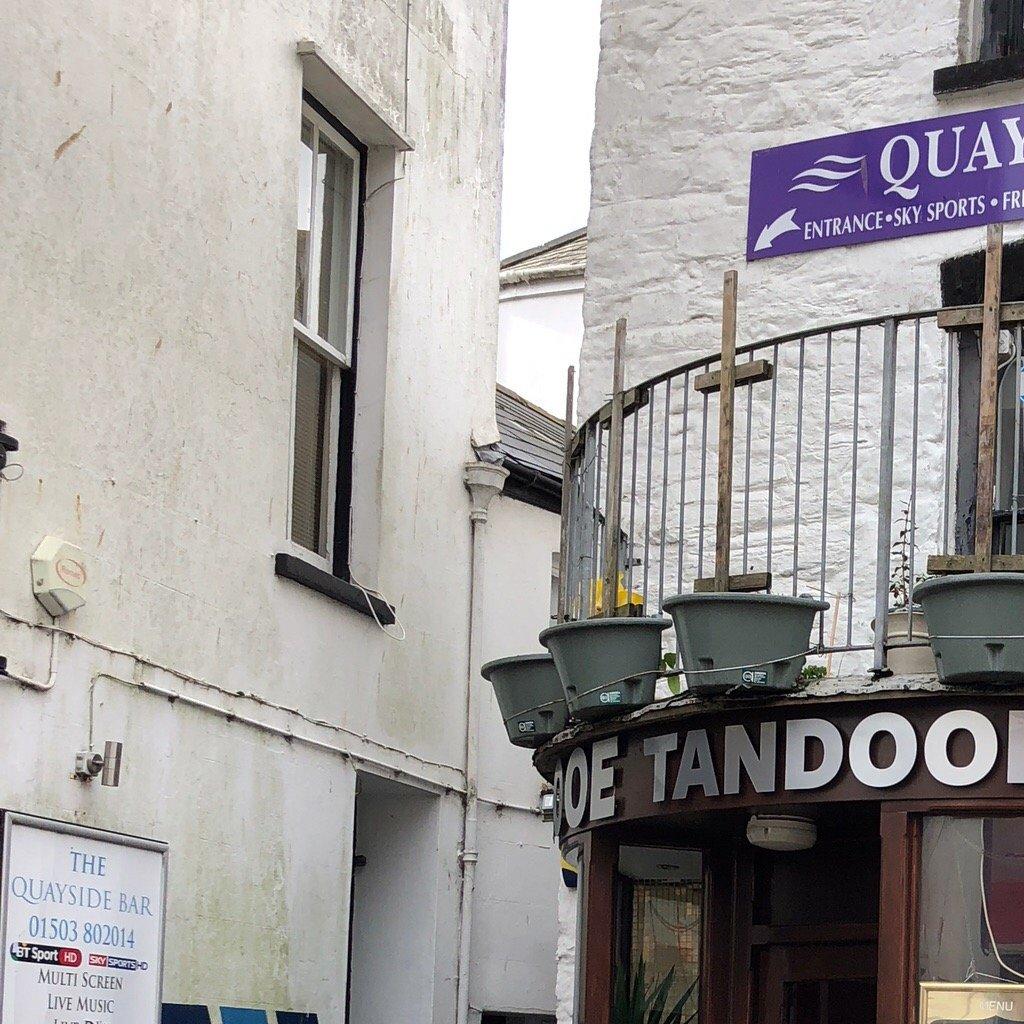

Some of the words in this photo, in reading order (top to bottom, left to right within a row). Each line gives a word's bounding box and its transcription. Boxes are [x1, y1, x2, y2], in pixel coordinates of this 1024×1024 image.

[803, 211, 884, 241] ENTRANCE
[892, 207, 923, 230] SKY
[926, 194, 986, 225] SPORTS
[554, 736, 618, 834] OOE
[71, 852, 106, 877] THE
[11, 877, 111, 911] QUAYSIDE
[119, 890, 153, 917] BAR
[29, 915, 78, 943] 01503
[83, 922, 135, 948] 802014
[32, 946, 58, 962] Sport
[64, 952, 77, 963] HD
[90, 955, 106, 965] SKY
[109, 958, 136, 969] SPORTS
[38, 969, 77, 987] MULTI
[82, 972, 123, 990] SCREEN
[47, 994, 72, 1011] LIVE
[77, 996, 115, 1014] MUSIC
[980, 1000, 1013, 1012] MENU
